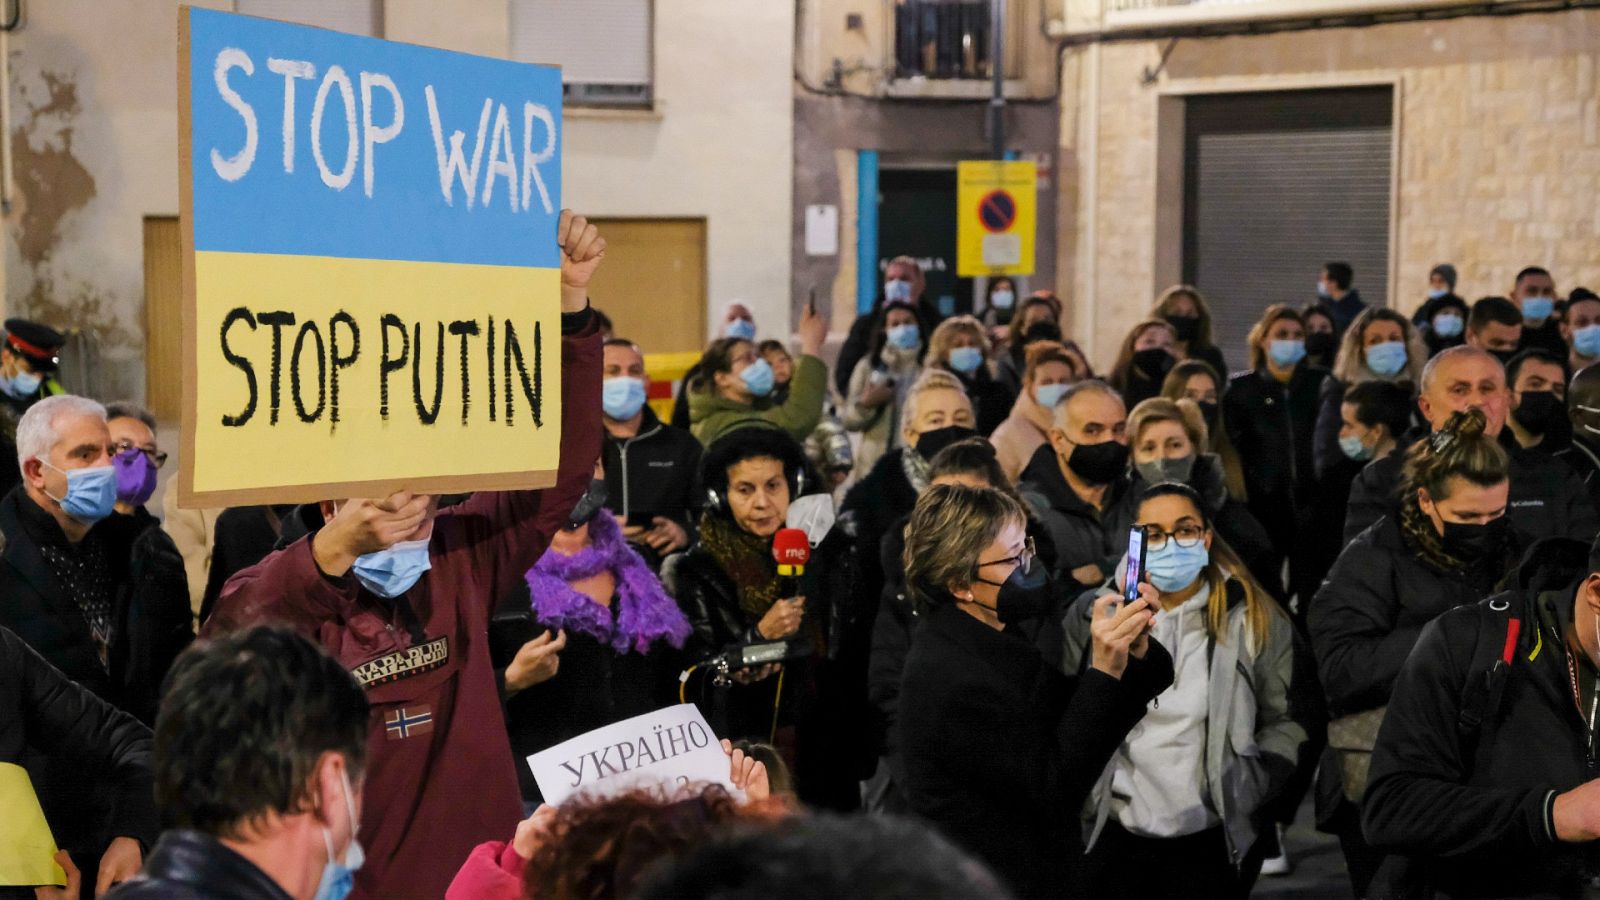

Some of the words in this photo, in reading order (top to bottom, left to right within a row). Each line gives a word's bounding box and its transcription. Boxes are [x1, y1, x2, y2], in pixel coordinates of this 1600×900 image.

[211, 47, 404, 199] STOP
[425, 84, 556, 215] WAR
[221, 306, 361, 436] STOP
[379, 312, 543, 430] PUTIN
[785, 547, 806, 560] rne
[353, 638, 448, 685] NAPAPIJRI
[559, 720, 709, 788] УКРАЇНО
